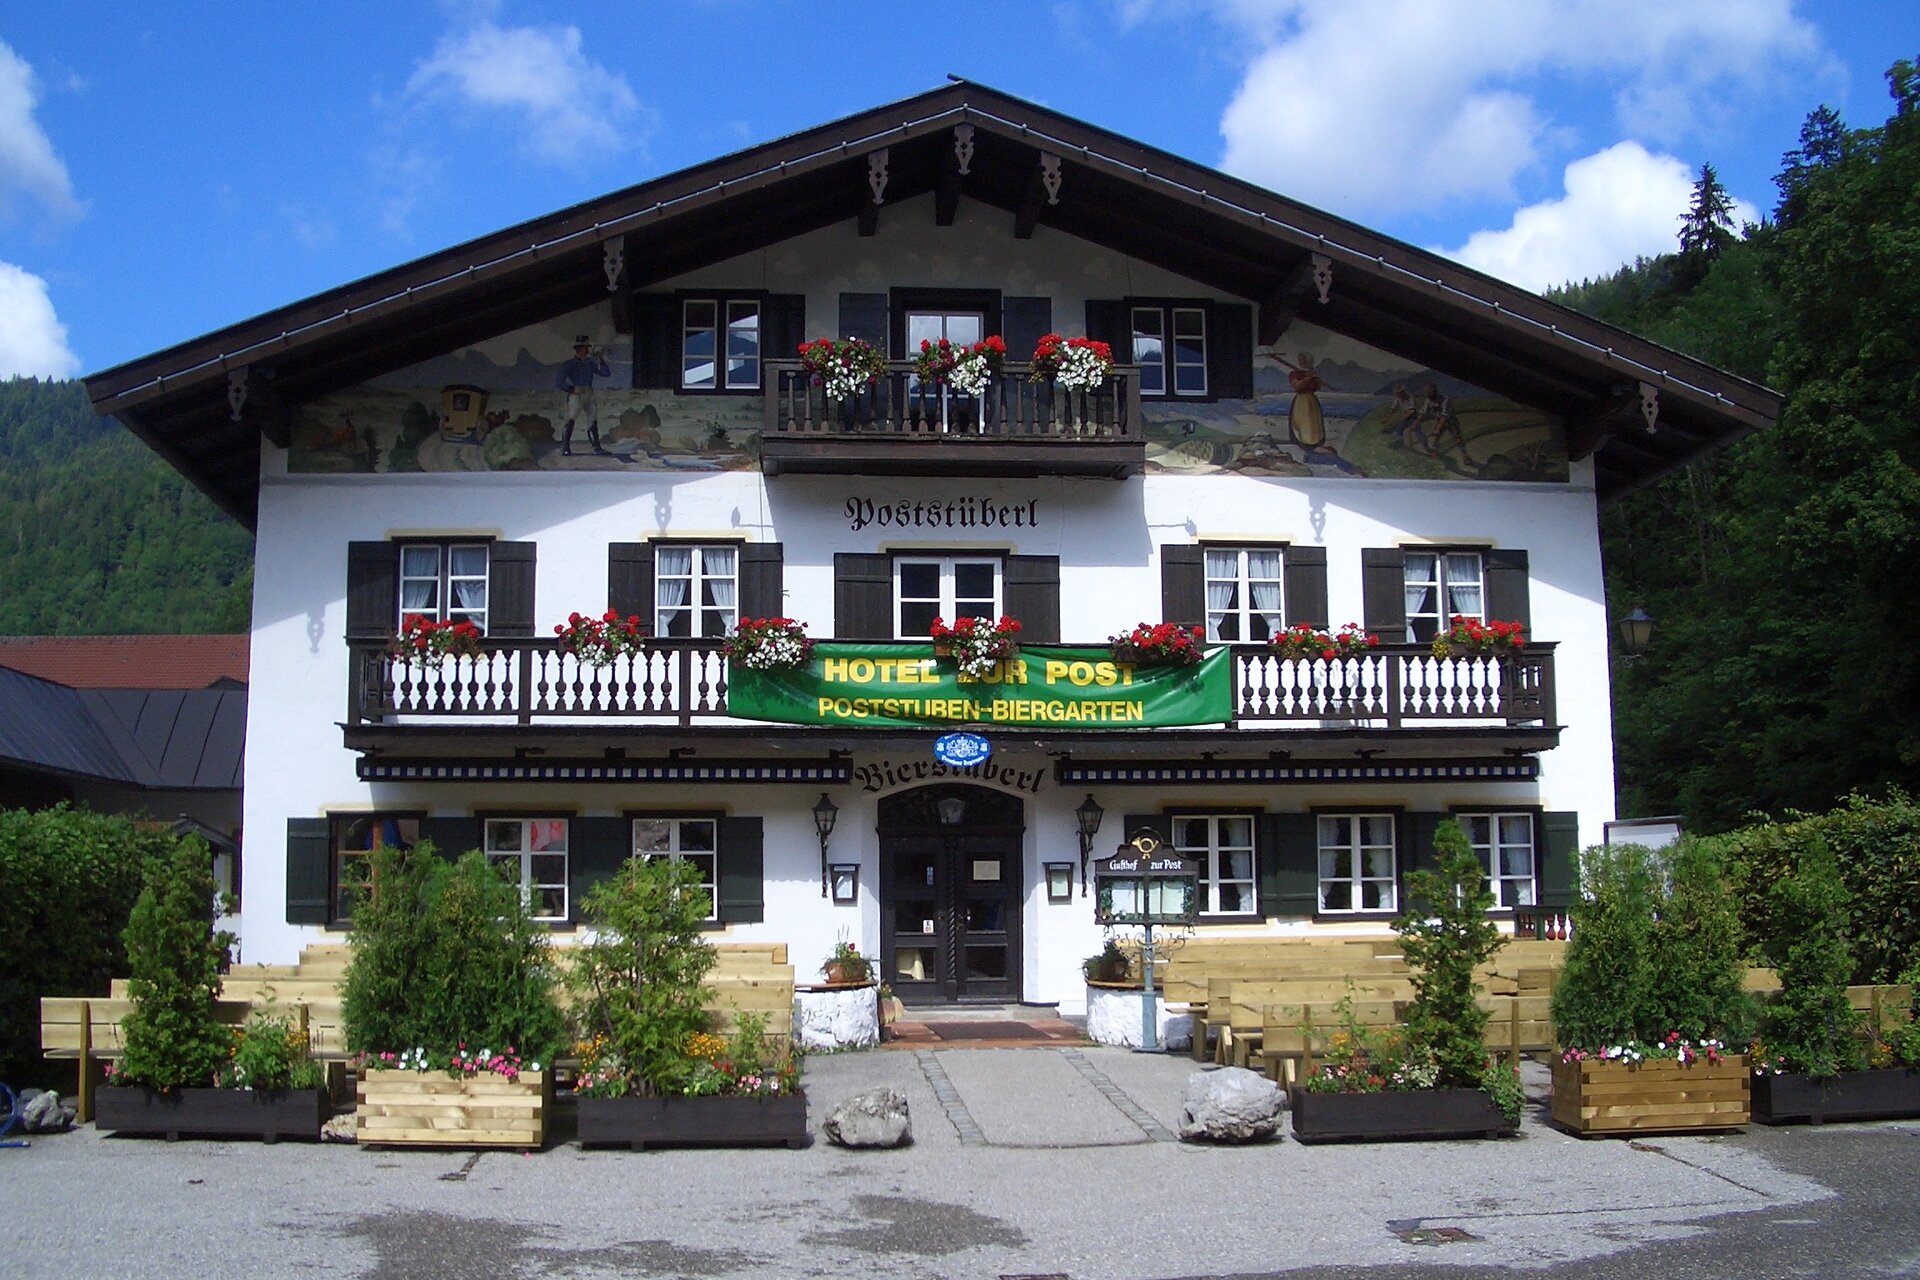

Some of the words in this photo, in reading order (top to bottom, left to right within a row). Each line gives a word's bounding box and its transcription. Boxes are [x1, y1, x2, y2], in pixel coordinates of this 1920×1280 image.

[844, 496, 1039, 531] Poststüberl
[823, 657, 941, 684] HOTEL
[1045, 660, 1137, 686] POST
[818, 696, 1143, 722] POSTSTUBEN-BIERGARTEN
[1163, 859, 1182, 870] Post
